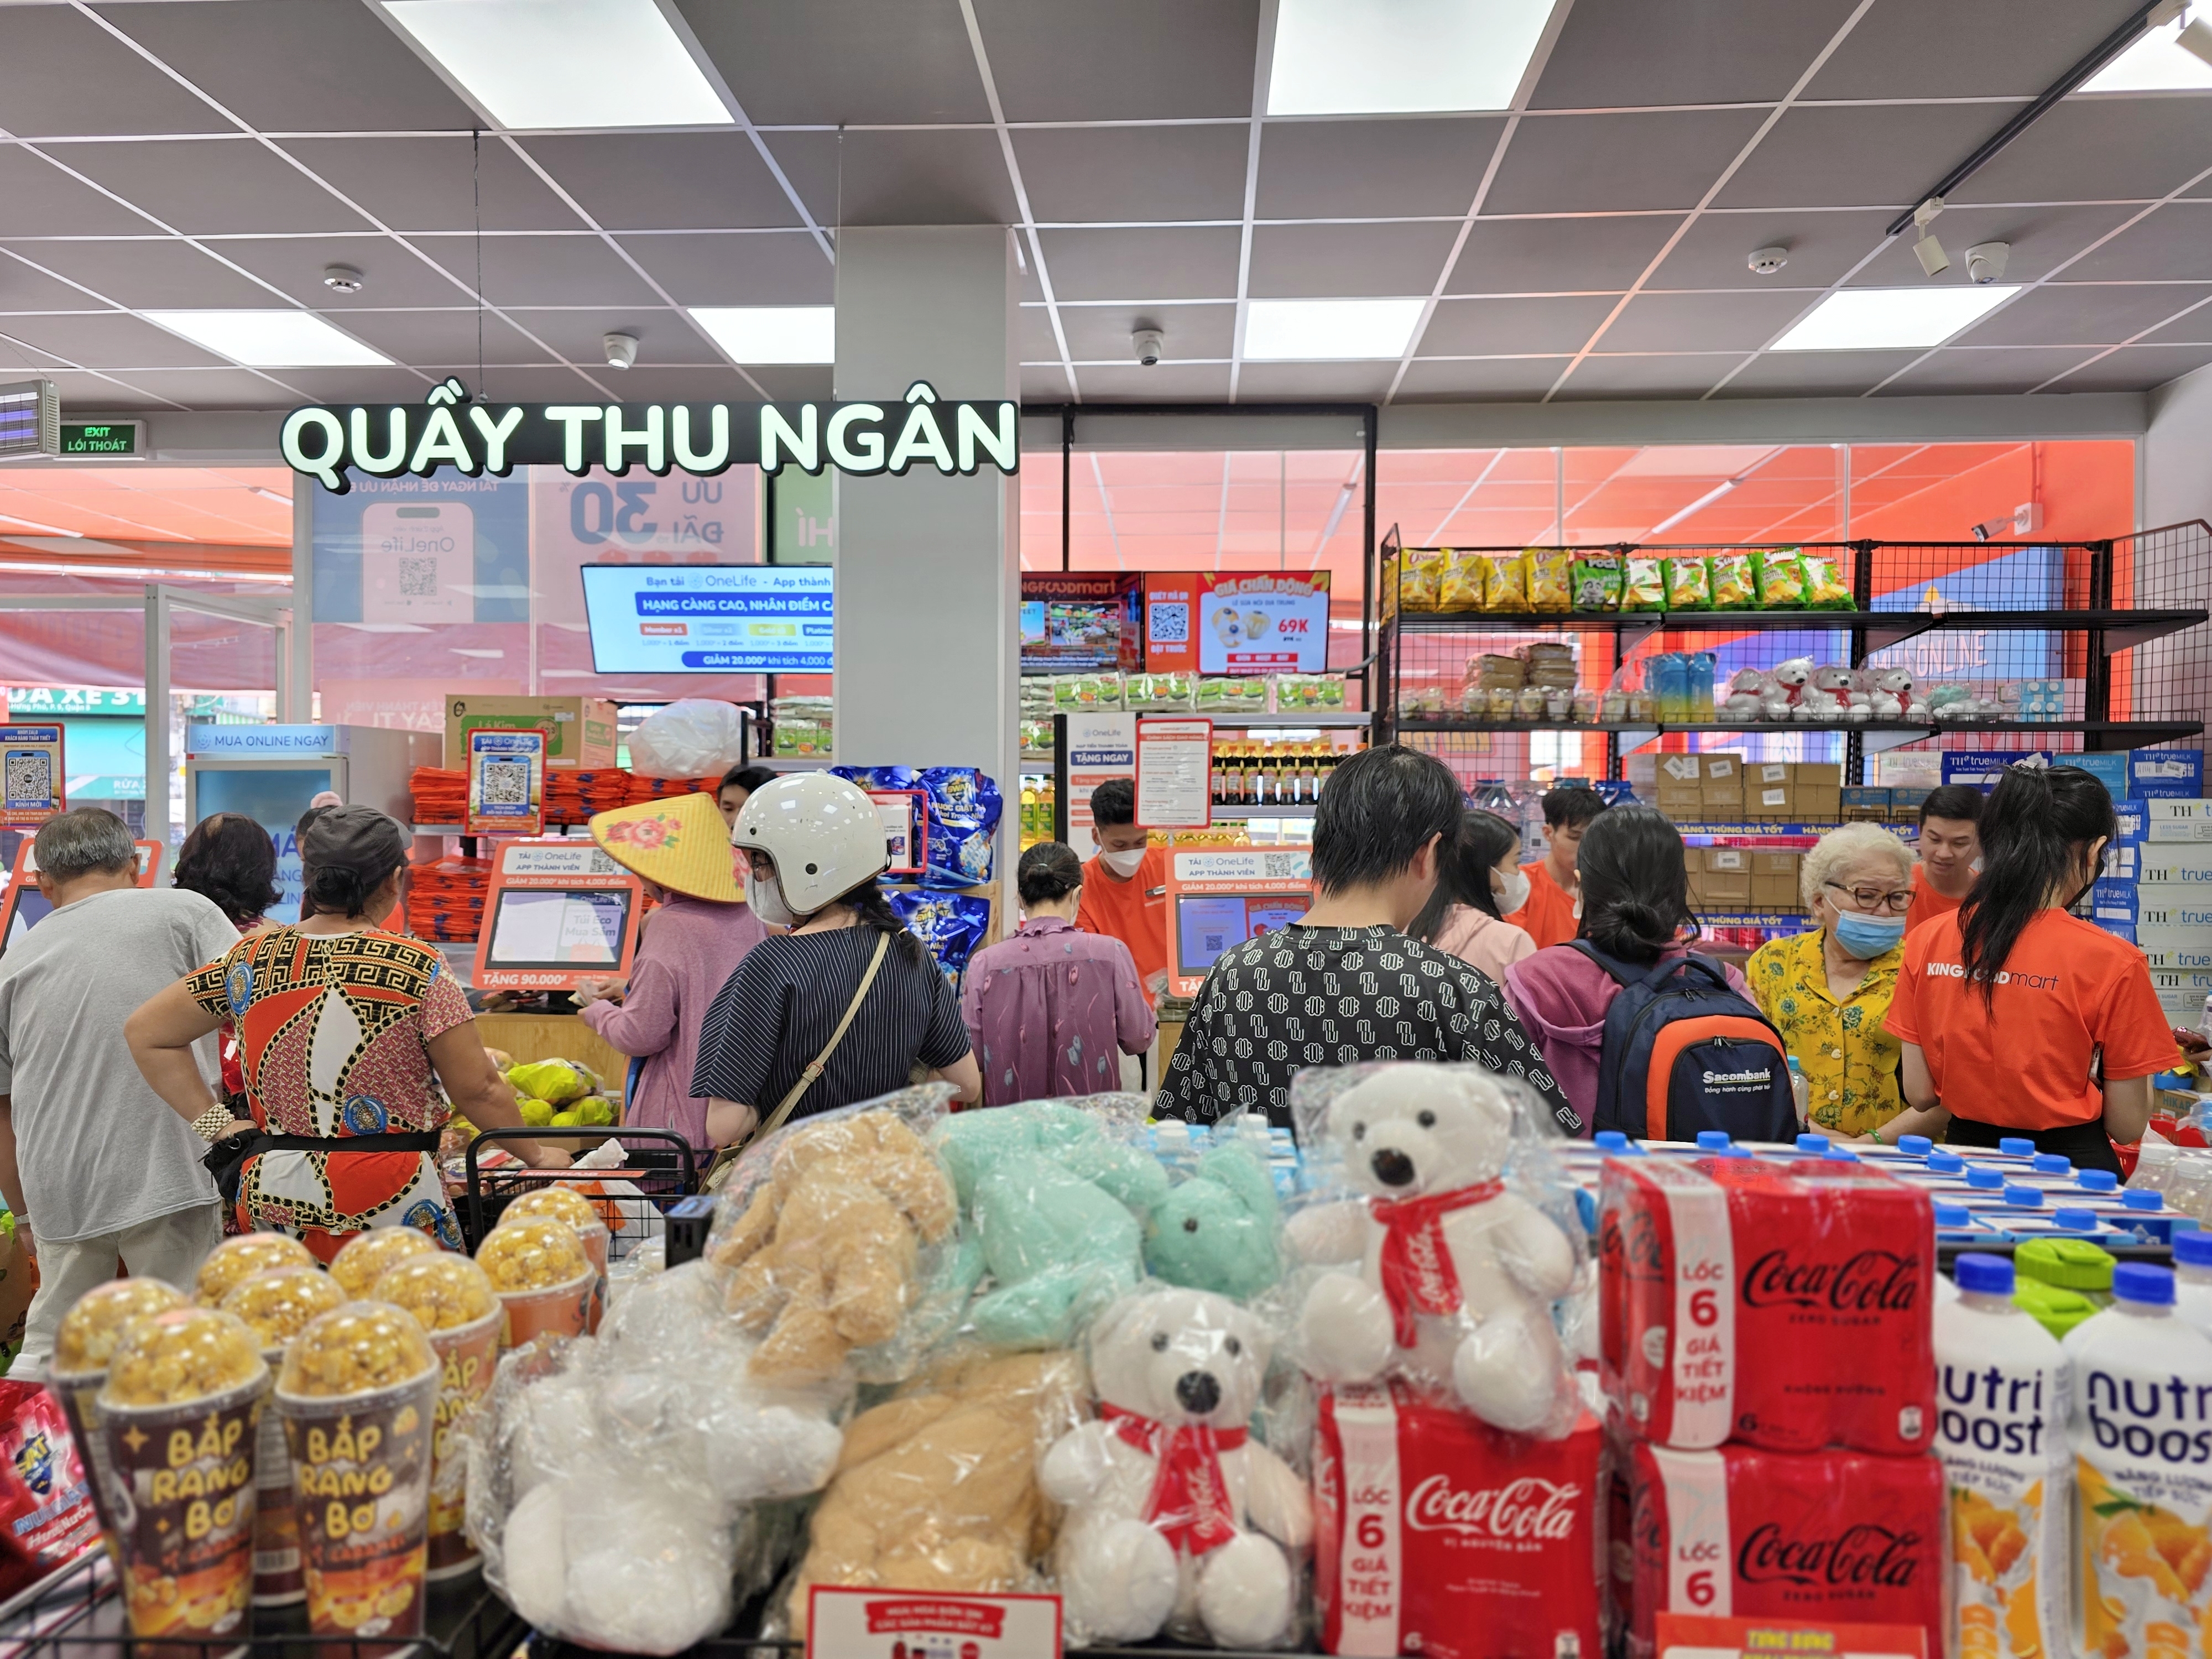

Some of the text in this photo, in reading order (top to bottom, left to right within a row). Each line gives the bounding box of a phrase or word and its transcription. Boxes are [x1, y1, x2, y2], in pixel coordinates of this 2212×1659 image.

[85, 427, 111, 437] EXIT
[282, 379, 1016, 489] QUẦY THU NGÂN
[88, 438, 127, 451] THOÁT
[646, 577, 667, 588] Bạn
[705, 575, 757, 587] OneLife
[773, 577, 795, 588] App
[799, 577, 831, 586] thành
[1215, 578, 1238, 597] GIÁ
[1274, 577, 1313, 597] ĐỘNG
[643, 599, 679, 613] HẠNG
[681, 597, 716, 611] CÀNG
[718, 599, 748, 612] CAO,
[788, 596, 819, 611] ĐIỂM
[1278, 618, 1309, 633] 69K
[703, 654, 799, 665] GIẢM khi tích
[1917, 630, 1989, 678] ONLINE
[215, 734, 328, 747] MUA ONLINE NGAY
[1074, 752, 1129, 765] TẶNG NGAY
[1950, 757, 1964, 766] TH
[114, 779, 140, 789] RỬA
[2170, 805, 2192, 817] TH
[1706, 824, 1784, 834] THÙNG GIÁ TỐT
[545, 852, 582, 861] OneLife
[1216, 857, 1254, 865] OneLife
[2145, 868, 2212, 880] TH true
[1182, 881, 1204, 891] GIẢM
[592, 916, 612, 925] Eco
[1708, 915, 1783, 926] THÙNG GIÁ TỐT
[2144, 910, 2212, 922] TH true
[565, 927, 588, 937] Mua
[2146, 952, 2210, 966] TH true
[482, 972, 519, 988] TẶNG
[2157, 974, 2180, 986] TH
[1703, 1068, 1771, 1084] Sacombank
[1682, 1260, 1724, 1281] LỐC
[1742, 1249, 1921, 1311] Coca-Cola
[1689, 1289, 1719, 1327] 6
[1788, 1313, 1882, 1326] ZERO SUGAR
[1686, 1335, 1721, 1355] GIÁ
[1682, 1358, 1725, 1379] TIẾT
[1676, 1384, 1726, 1406] KIỆM
[1936, 1364, 2043, 1413] utri
[2088, 1370, 2212, 1421] nutr
[167, 1410, 243, 1469] BẮP
[306, 1413, 383, 1465] BẮP
[1939, 1408, 2044, 1456] oost
[2088, 1402, 2212, 1463] boos
[152, 1457, 249, 1506] RANG
[300, 1463, 394, 1499] RANG
[1352, 1484, 1391, 1505] LỐC
[1405, 1474, 1582, 1539] Coca-Cola
[185, 1494, 237, 1541] BƠ
[325, 1499, 377, 1540] BƠ
[1357, 1514, 1386, 1549] 6
[1678, 1539, 1721, 1563] LỐC
[1737, 1522, 1922, 1588] Coca-Cola
[1351, 1554, 1389, 1573] GIÁ
[1347, 1577, 1392, 1595] TIẾT
[1686, 1570, 1717, 1607] 6
[1783, 1589, 1876, 1602] ZERO SUGAR
[1344, 1601, 1392, 1621] KIỆM
